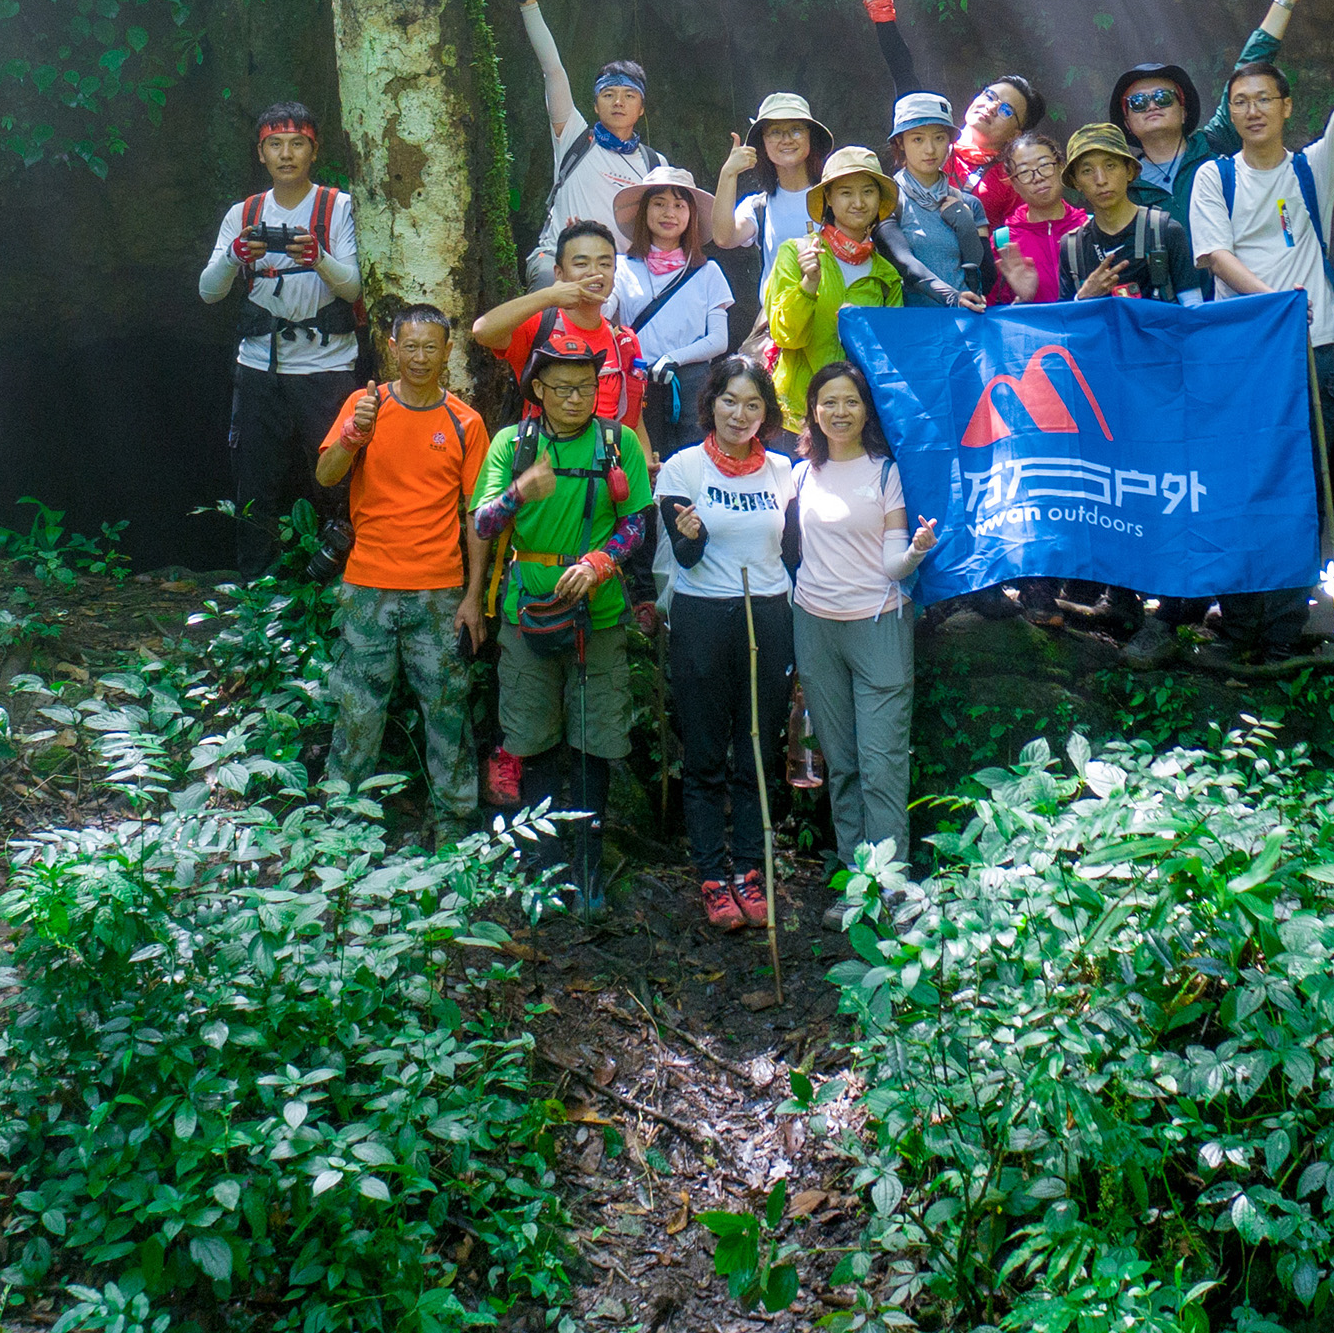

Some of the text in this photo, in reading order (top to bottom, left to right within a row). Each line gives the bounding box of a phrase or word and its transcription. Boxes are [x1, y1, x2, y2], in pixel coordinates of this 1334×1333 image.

[707, 486, 780, 512] PUMA
[965, 504, 1145, 538] wwan outdoors
